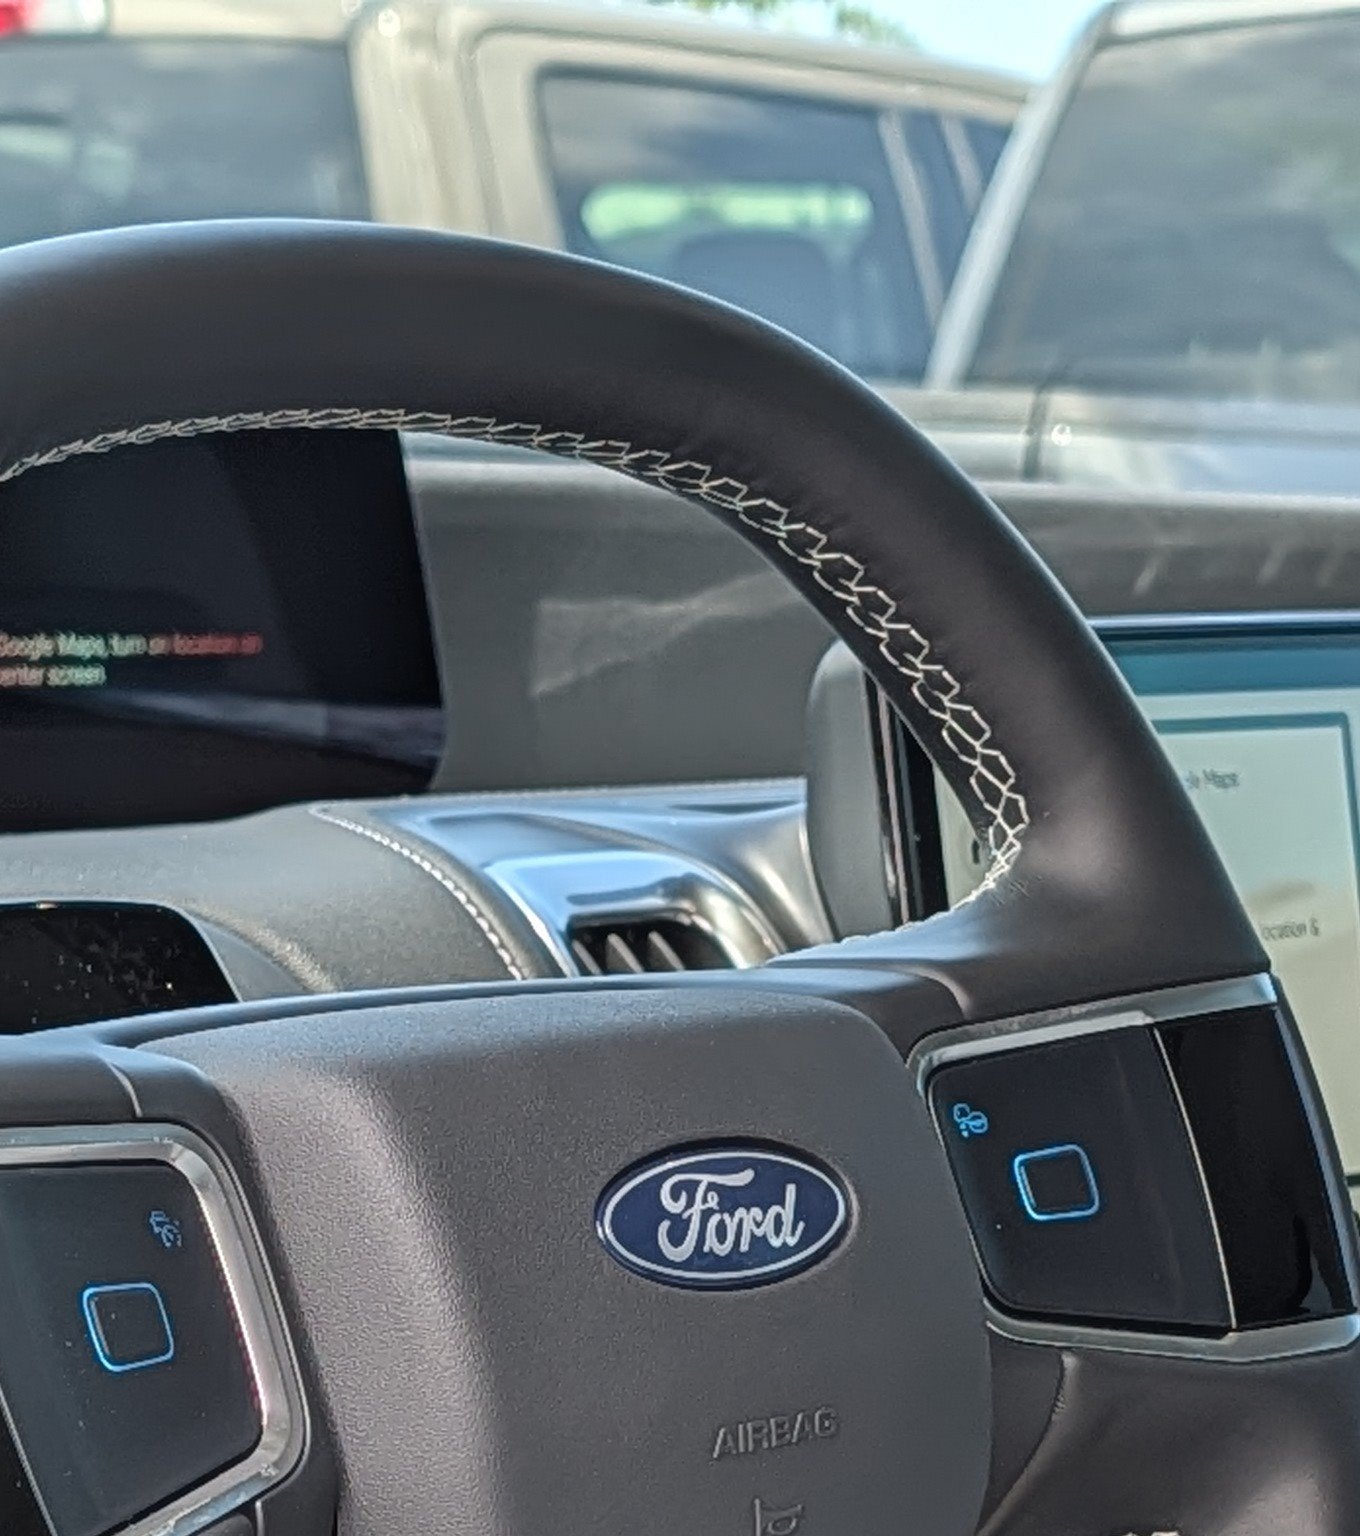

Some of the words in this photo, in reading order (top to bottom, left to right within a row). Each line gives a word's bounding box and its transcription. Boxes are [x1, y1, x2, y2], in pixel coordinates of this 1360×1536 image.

[45, 664, 106, 688] screen
[657, 1168, 806, 1262] Ford
[711, 1405, 840, 1459] AIRBAG
